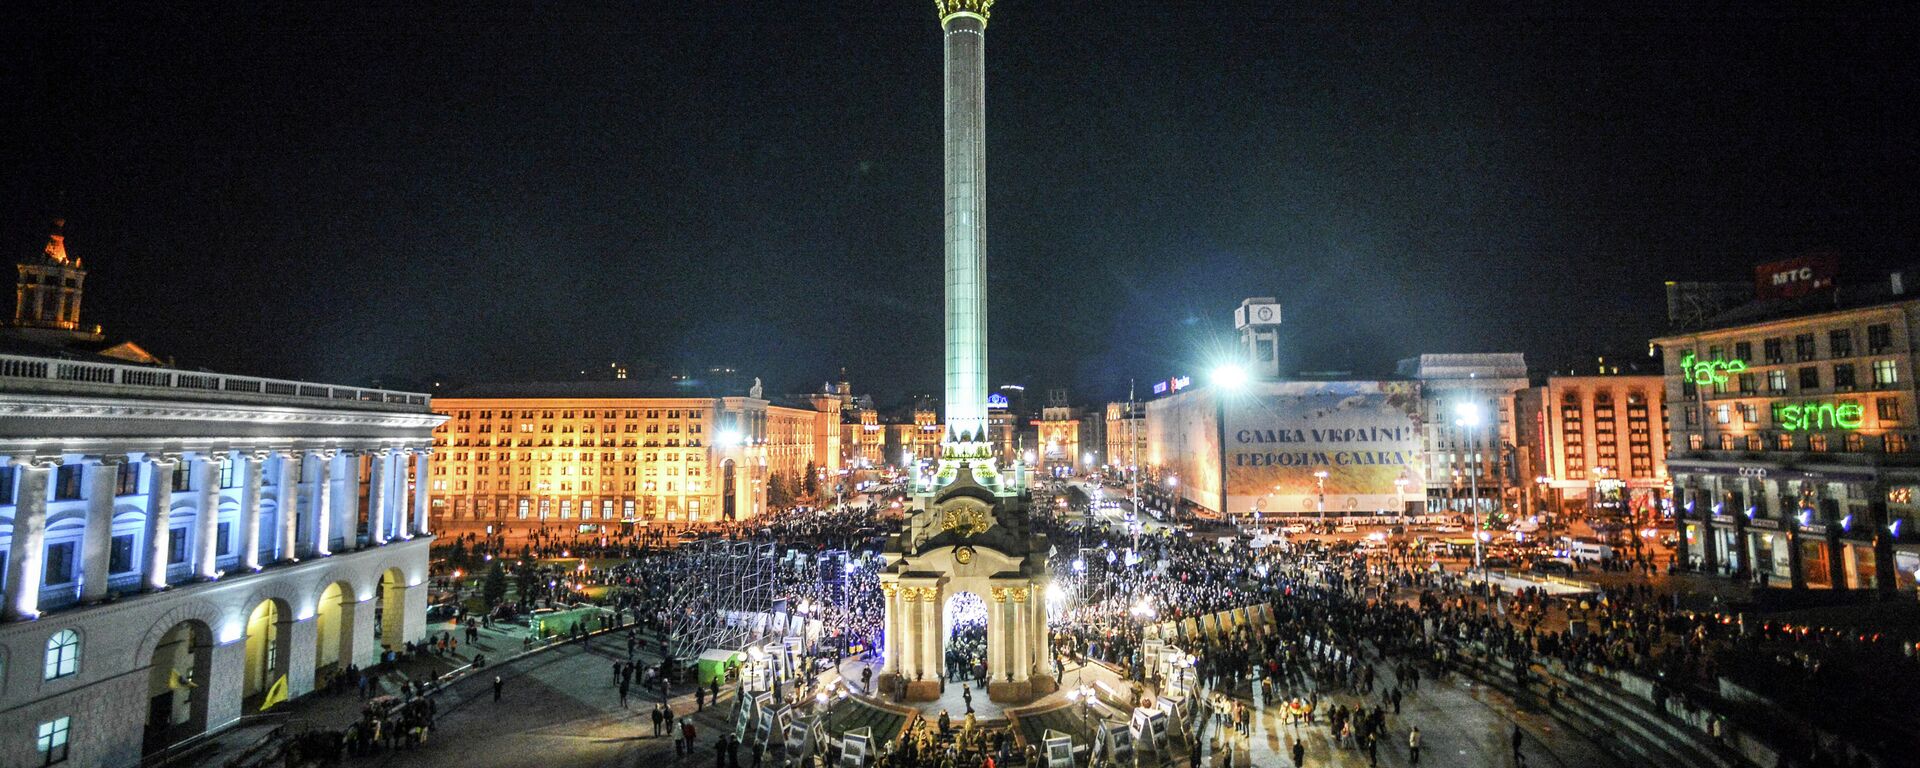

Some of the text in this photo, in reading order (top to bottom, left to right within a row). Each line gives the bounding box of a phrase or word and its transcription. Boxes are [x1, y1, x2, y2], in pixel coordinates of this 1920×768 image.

[1771, 267, 1812, 286] МТС
[1236, 425, 1411, 443] СЛАВА УКРАЇНІ!
[1236, 450, 1413, 466] ГЕРОЯМ СЛАВА!
